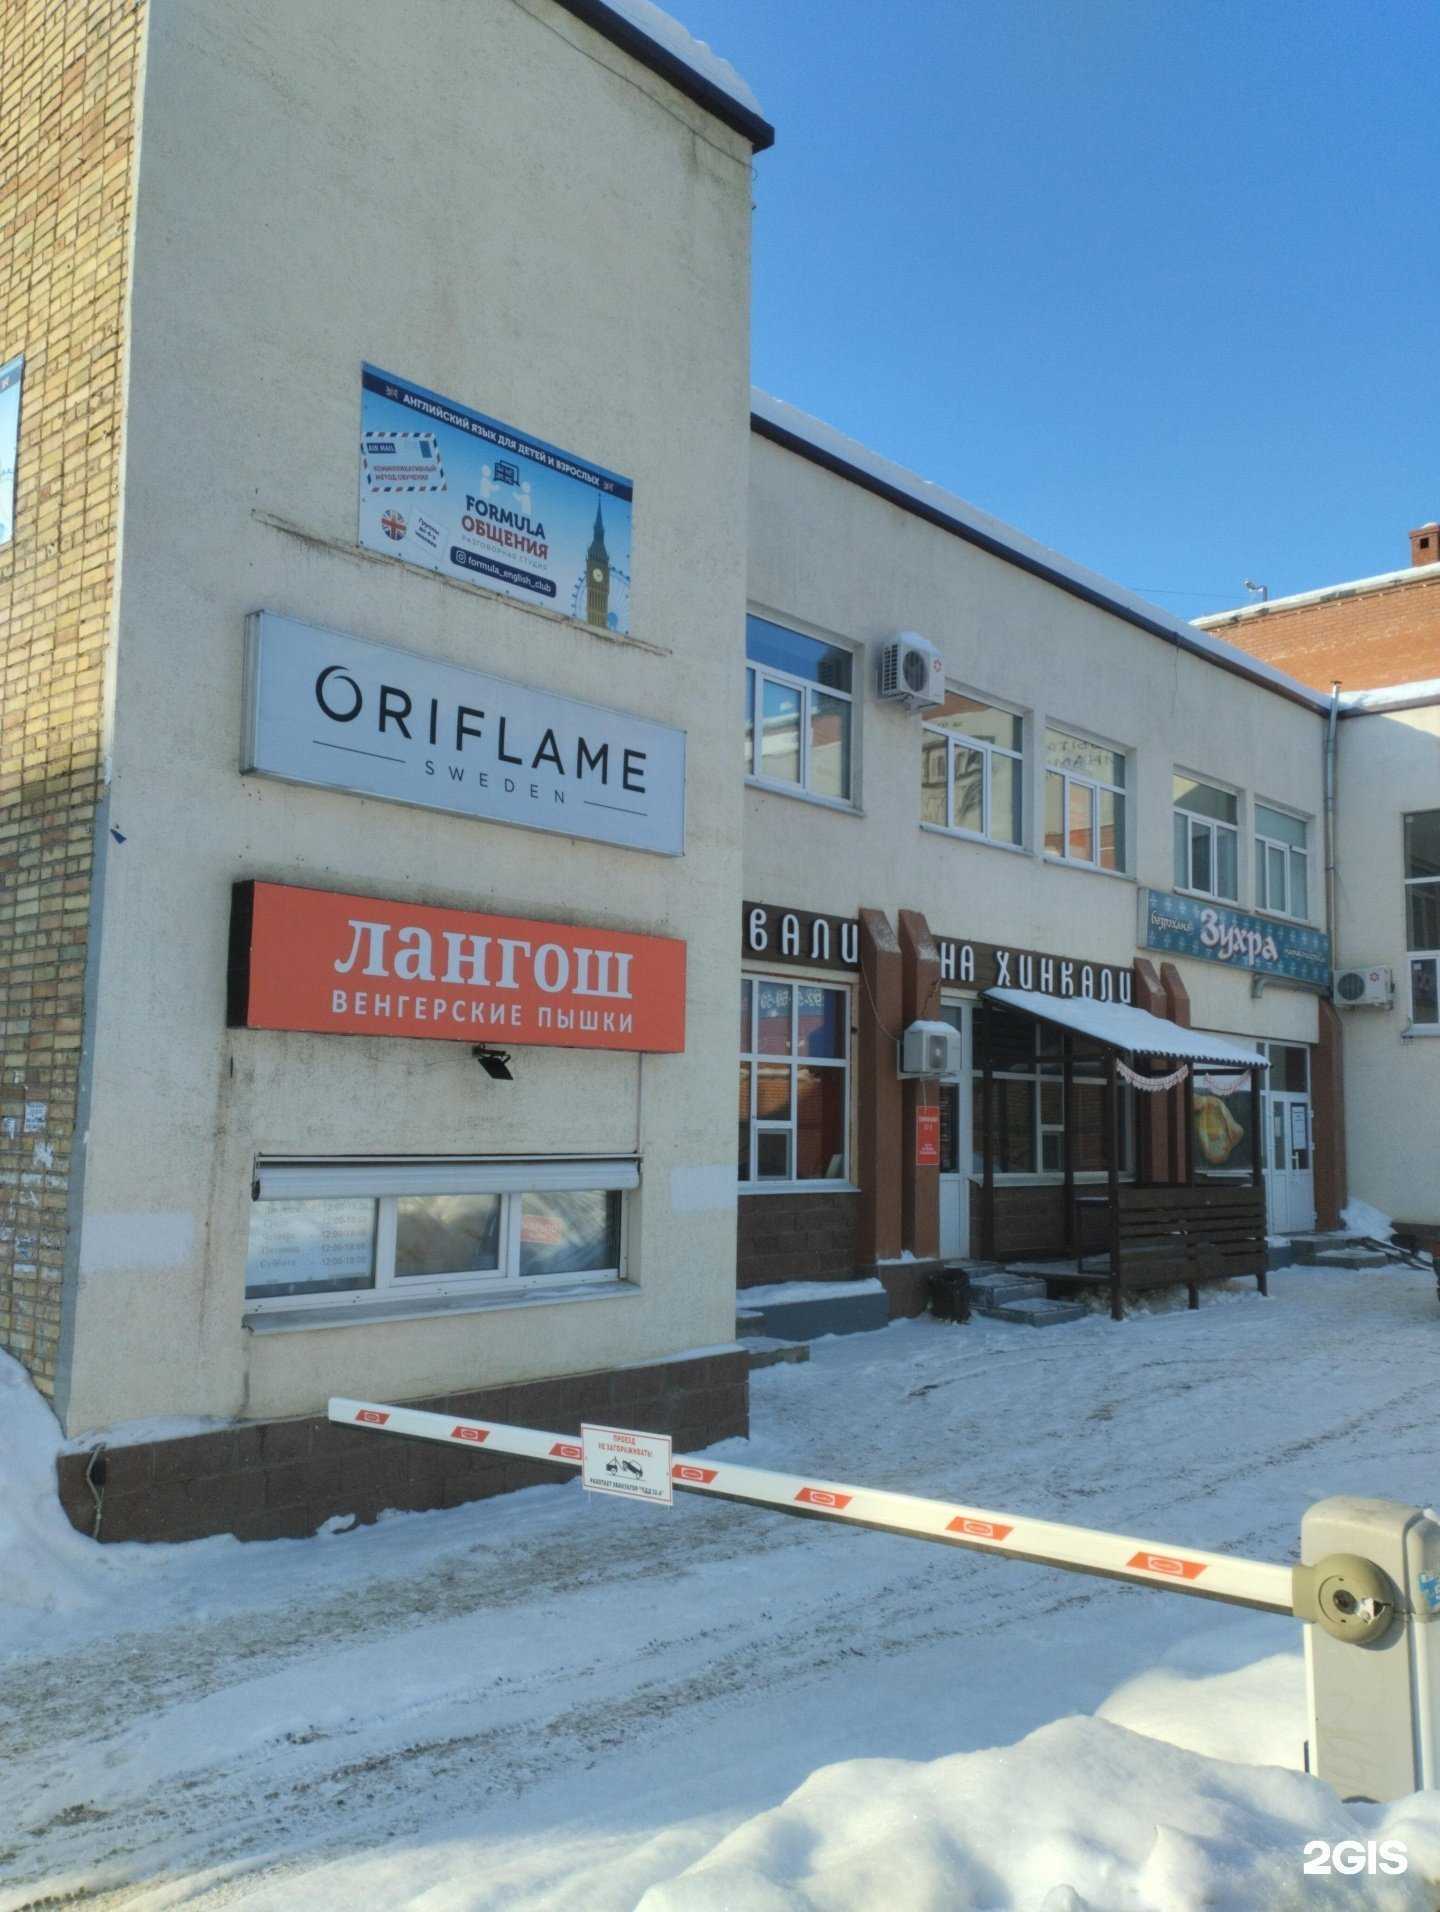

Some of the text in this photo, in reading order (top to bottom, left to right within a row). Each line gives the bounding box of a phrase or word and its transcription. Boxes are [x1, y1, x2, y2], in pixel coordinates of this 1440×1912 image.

[403, 394, 600, 487] АНГЛИЙСКИЙ ЯЗЫК ДЛЯ ДЕТЕЙ И ВЗРОСЛЫХ
[461, 515, 549, 560] ОБЩЕНИЯ
[465, 494, 546, 540] FORMULA
[315, 664, 647, 794] ORIFLAME
[425, 759, 565, 804] SWEDEN
[1199, 908, 1280, 966] Зухра
[940, 942, 975, 982] НА
[996, 950, 1132, 1004] ХИНКАЛИ
[332, 990, 634, 1034] ВЕНГЕРСКИЕ ПЫШКИ
[613, 1434, 636, 1445] ПРОЕЗД
